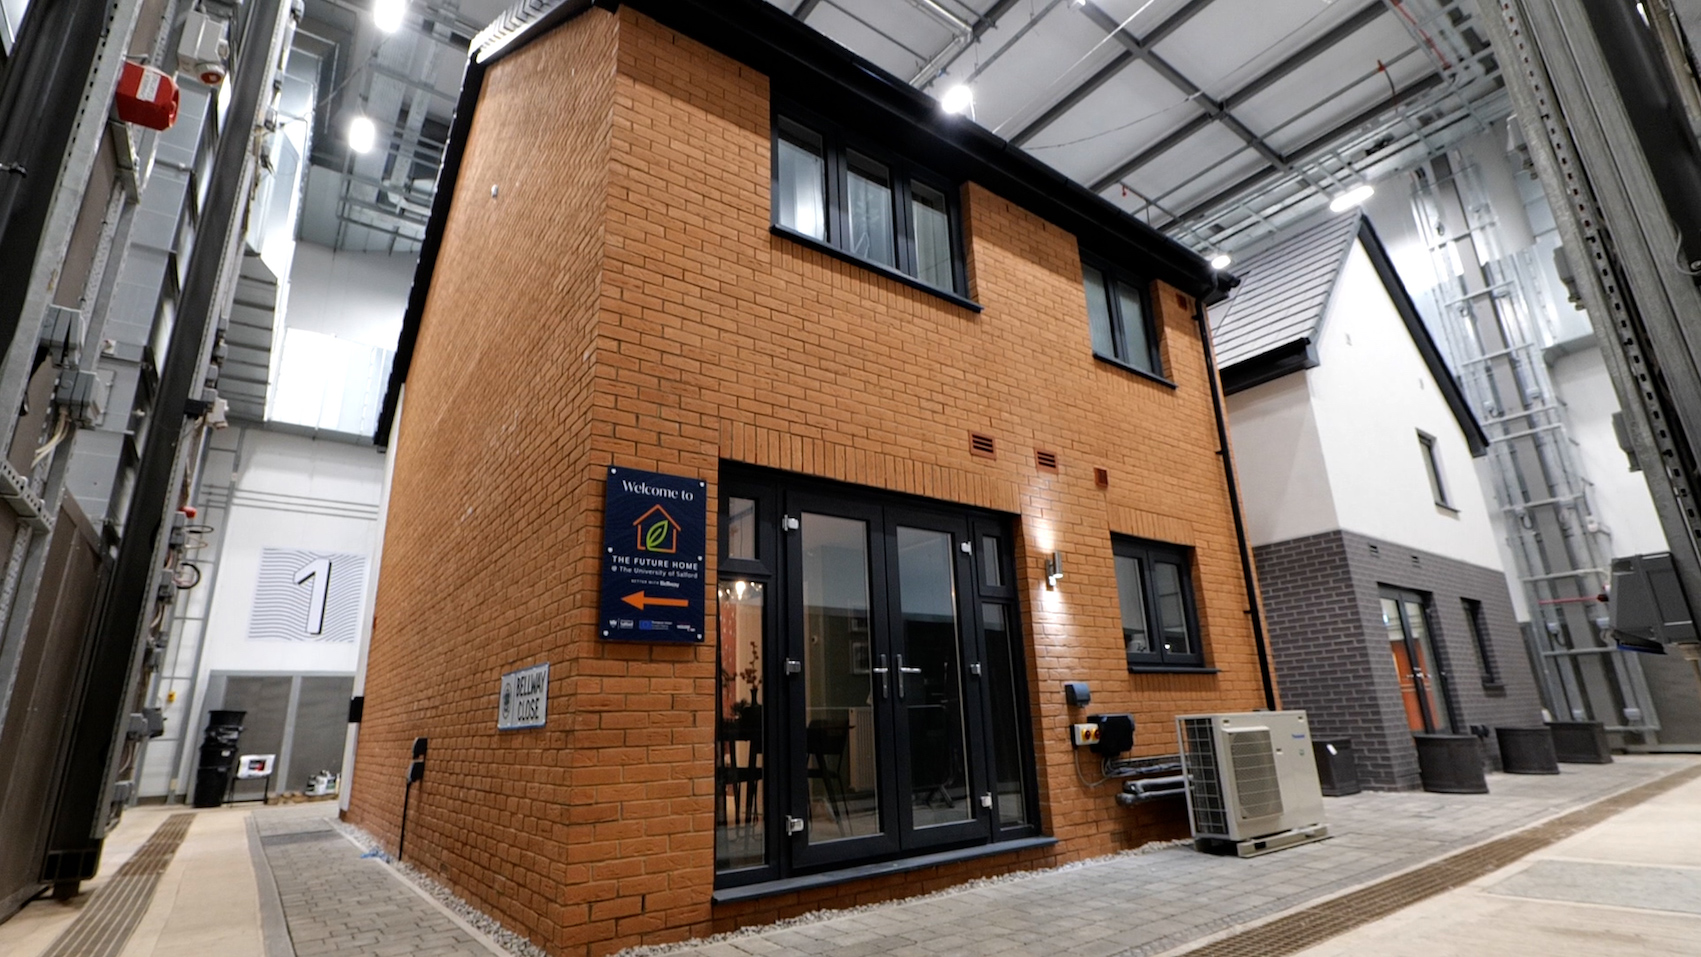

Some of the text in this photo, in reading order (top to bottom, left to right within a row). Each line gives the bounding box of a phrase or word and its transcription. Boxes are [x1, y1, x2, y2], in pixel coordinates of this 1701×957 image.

[622, 480, 694, 502] Welcome to
[612, 555, 698, 571] THE FUTURE HOME
[619, 566, 632, 574] The
[633, 568, 666, 578] University
[676, 571, 698, 579] Salford
[292, 558, 332, 635] 1
[516, 670, 546, 697] BELLWAY
[517, 697, 540, 721] CLOSE
